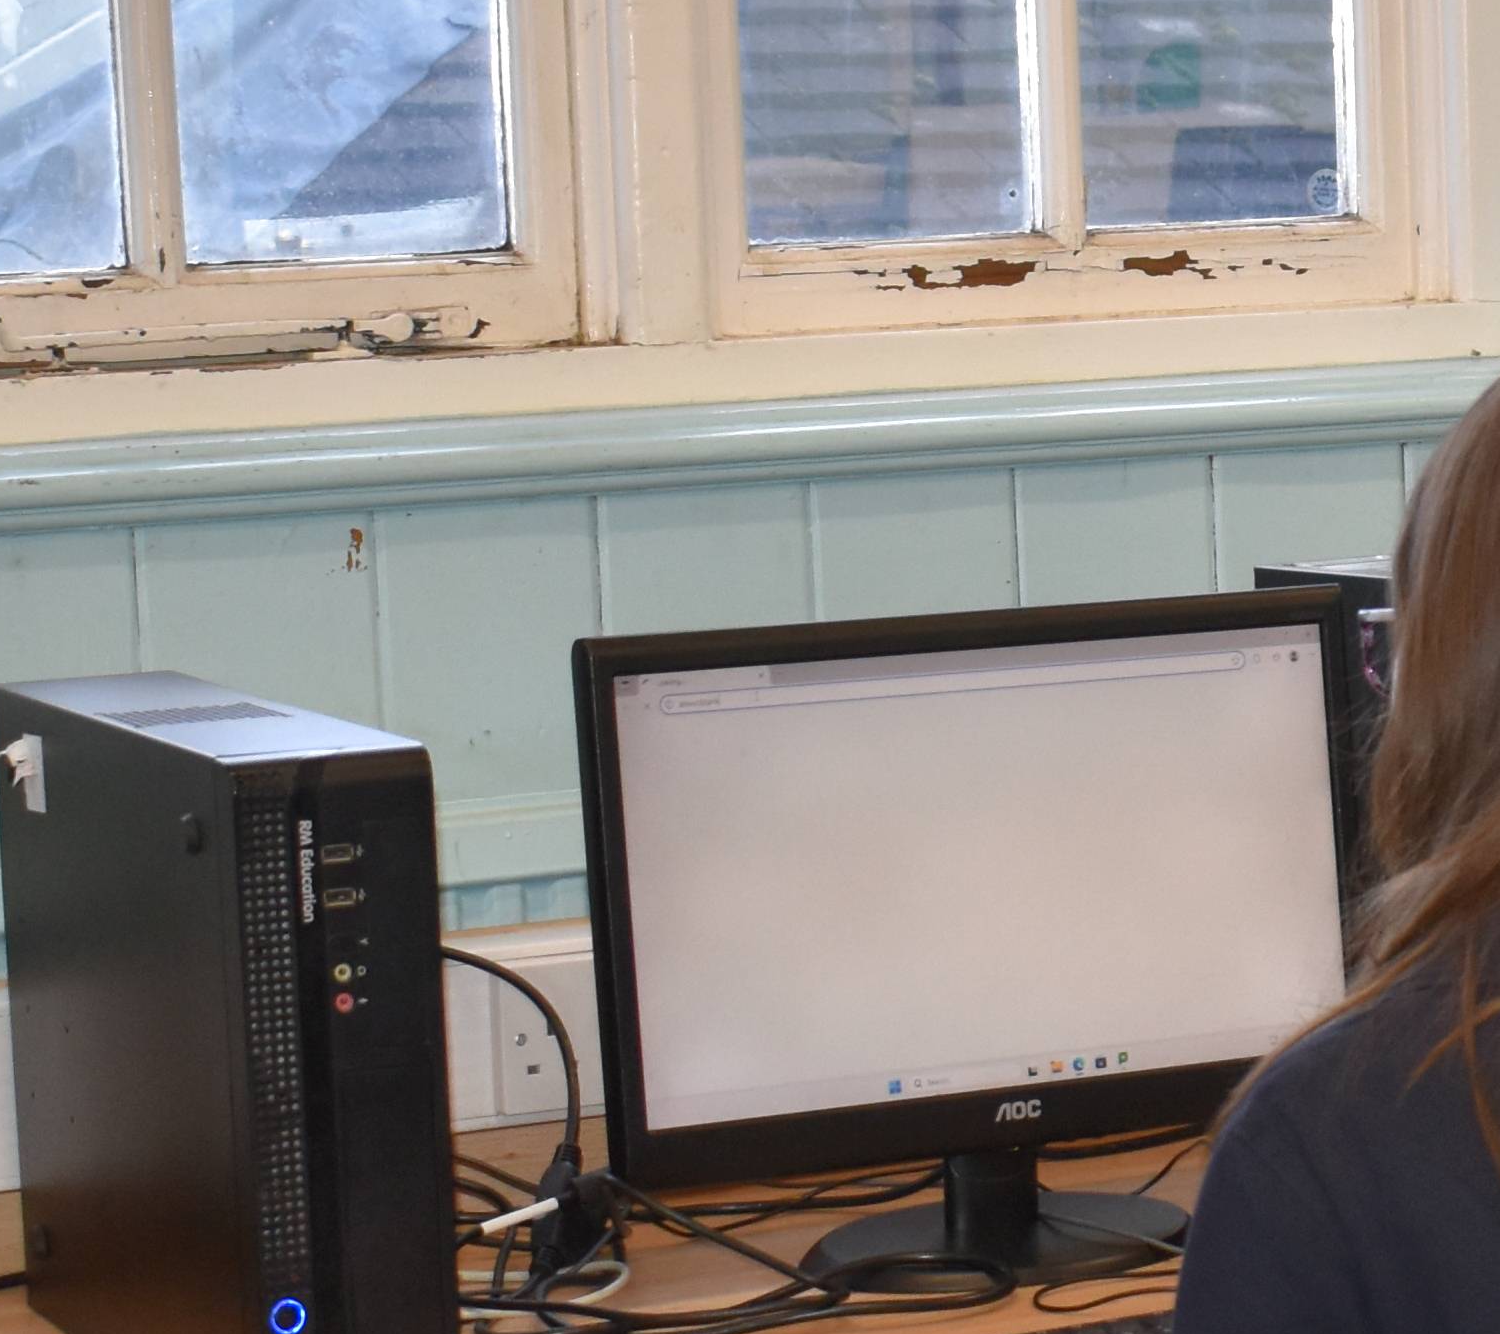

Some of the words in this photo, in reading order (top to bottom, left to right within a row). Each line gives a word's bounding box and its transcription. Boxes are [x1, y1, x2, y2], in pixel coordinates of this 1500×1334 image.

[298, 819, 313, 846] RM
[300, 848, 317, 923] Education
[995, 1098, 1043, 1123] AOC
